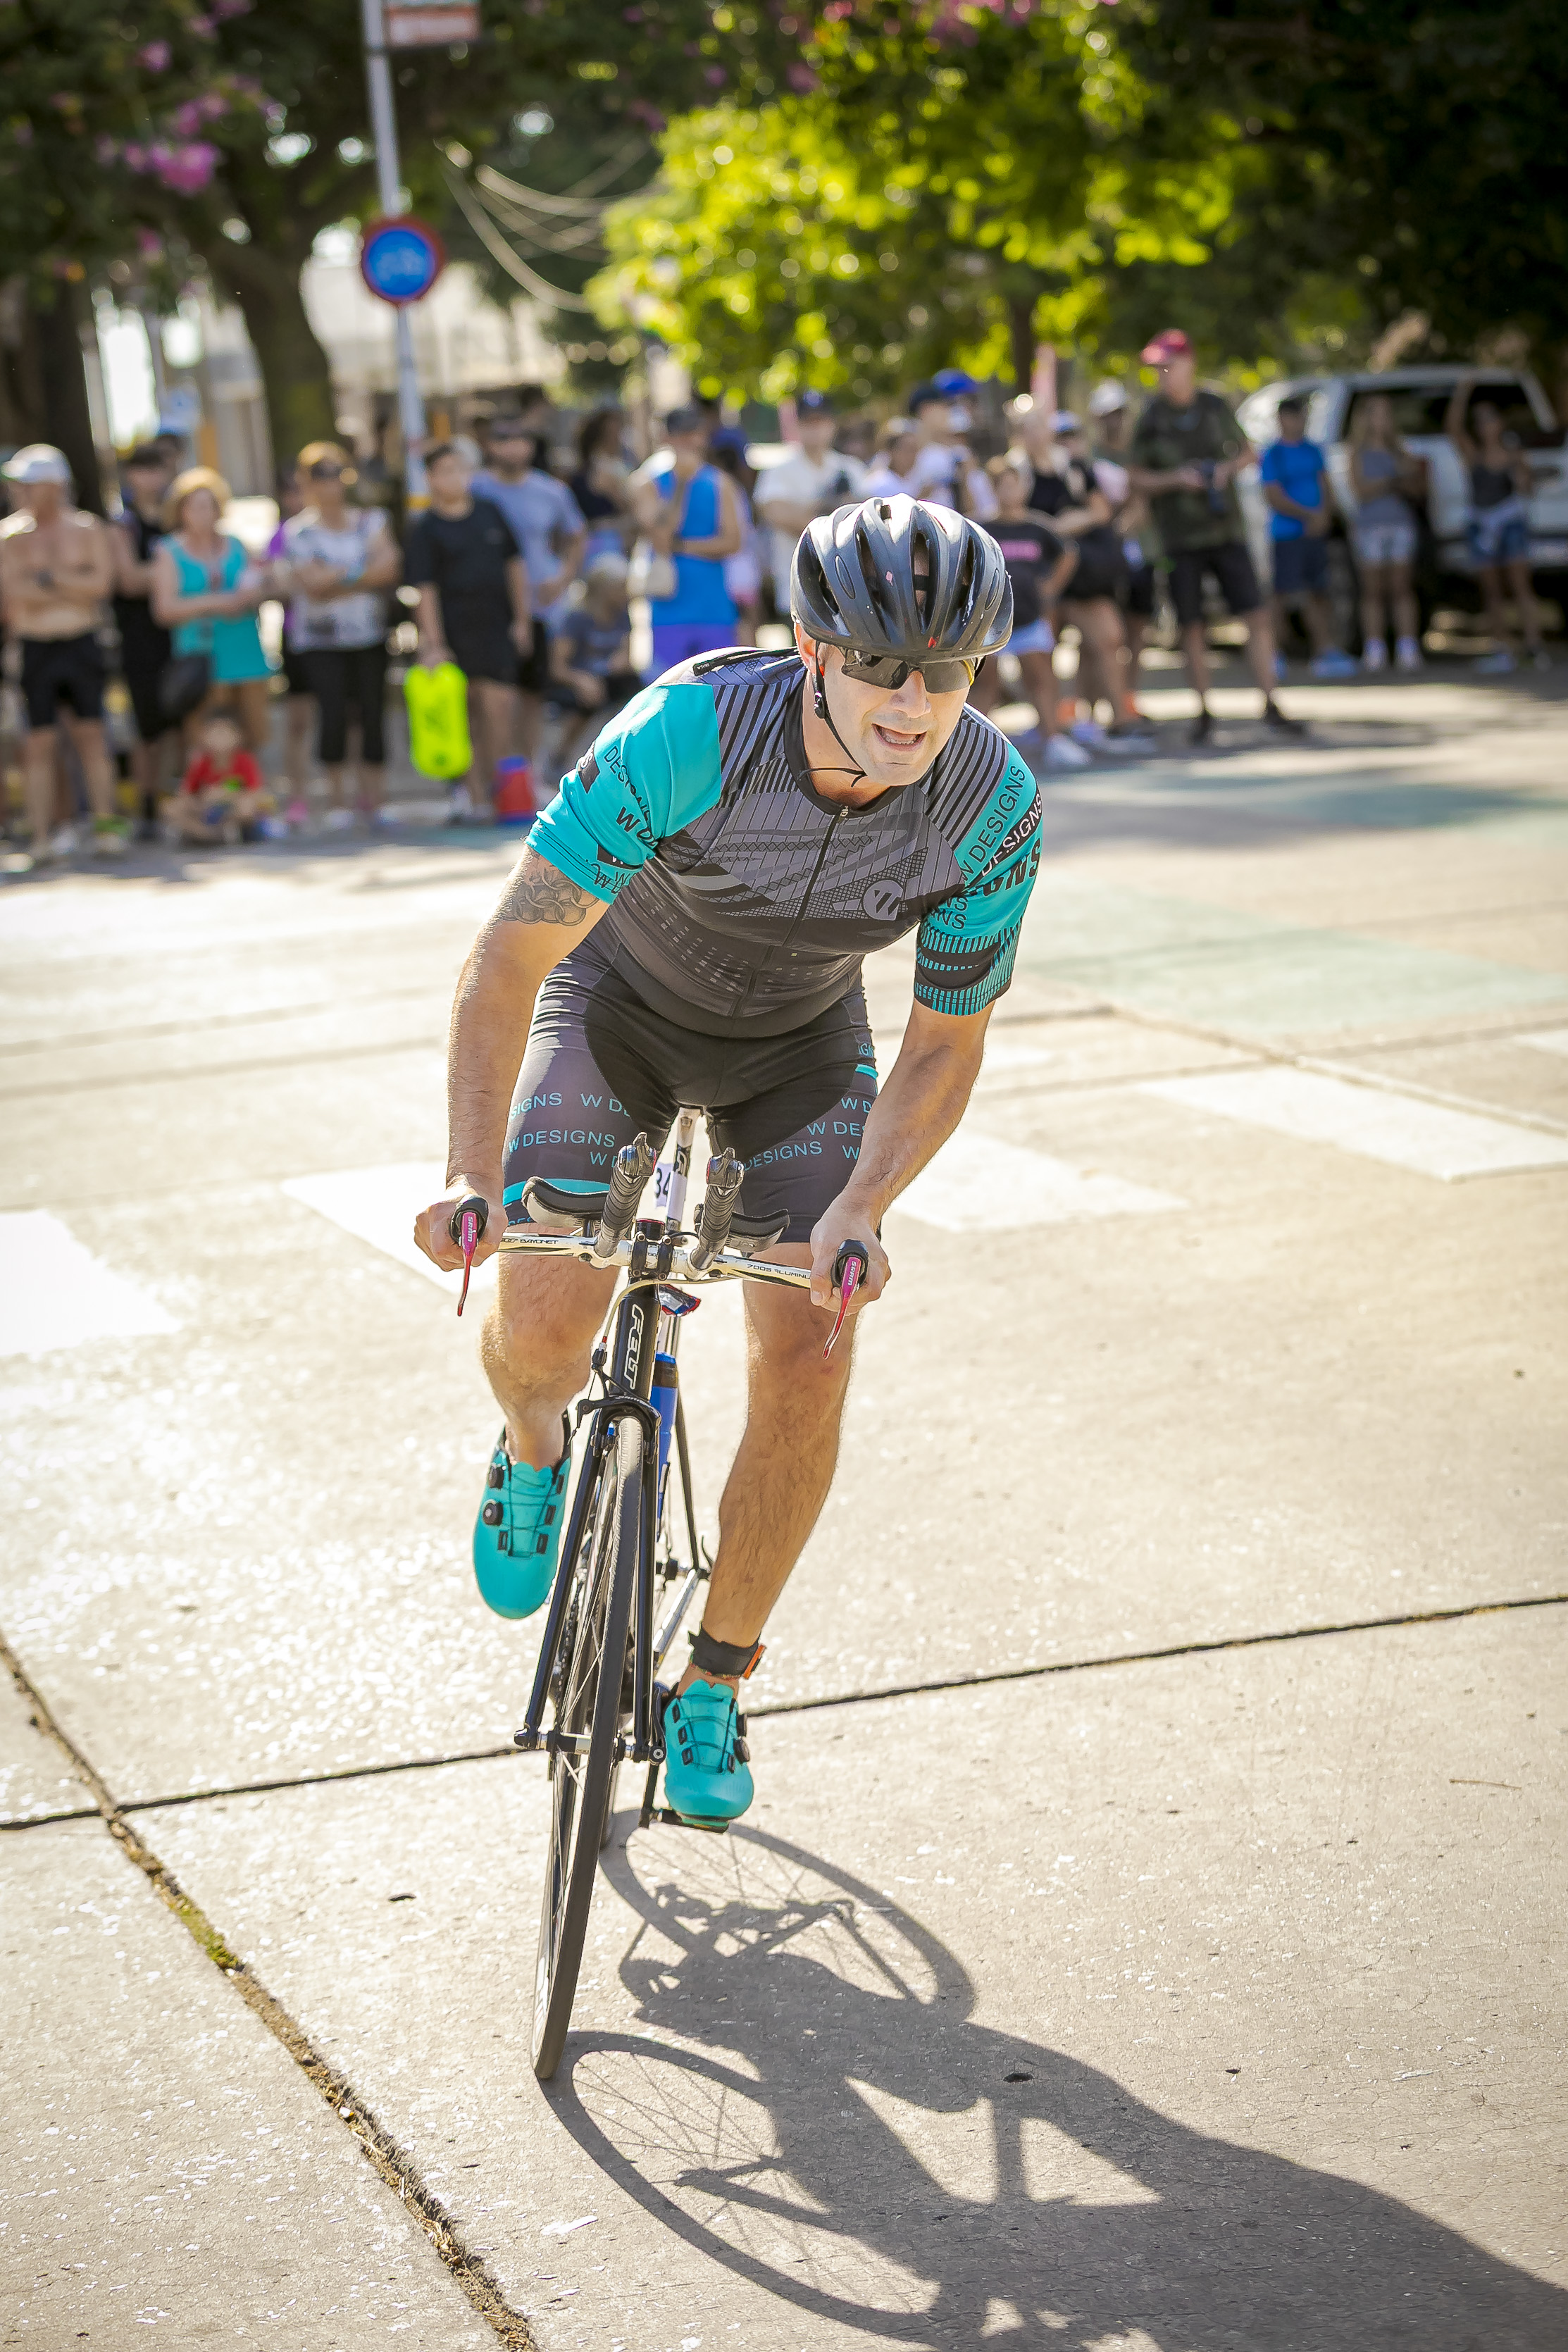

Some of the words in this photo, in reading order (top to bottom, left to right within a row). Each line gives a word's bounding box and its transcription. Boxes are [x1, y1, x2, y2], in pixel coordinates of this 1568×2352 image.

[616, 807, 641, 832] W
[968, 765, 1026, 864] DESIGNS
[580, 1093, 603, 1109] W
[841, 1097, 858, 1110] W
[509, 1137, 520, 1153] W
[523, 1129, 616, 1148] DESIGNS
[807, 1121, 826, 1135] W
[833, 1121, 866, 1137] DE
[590, 1151, 608, 1166] W
[847, 1260, 857, 1286] SRAM
[624, 1304, 644, 1390] FELT
